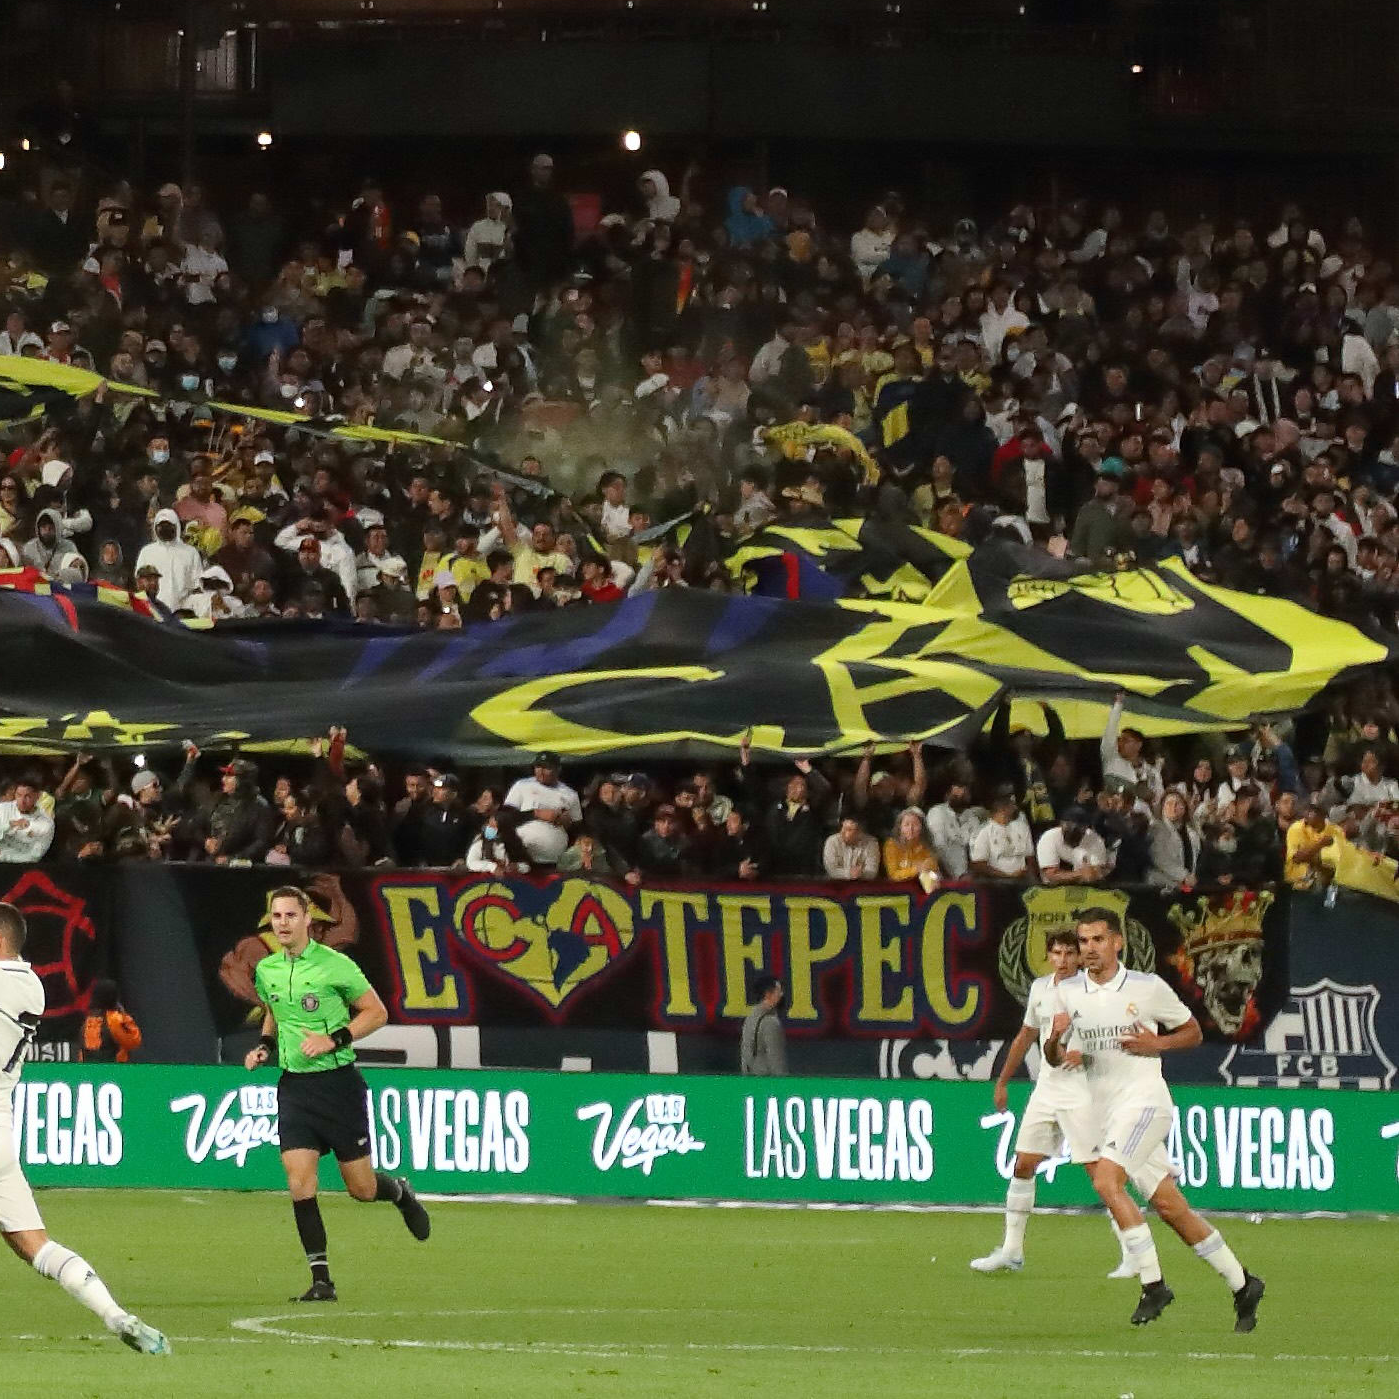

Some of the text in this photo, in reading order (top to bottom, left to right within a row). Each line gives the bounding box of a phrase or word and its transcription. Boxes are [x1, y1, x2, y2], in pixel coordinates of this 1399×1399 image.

[408, 1089, 530, 1174] VEGAS
[577, 1094, 705, 1175] Vegas
[745, 1096, 806, 1180] LAS
[812, 1098, 934, 1182] VEGAS
[1213, 1106, 1335, 1191] VEGAS
